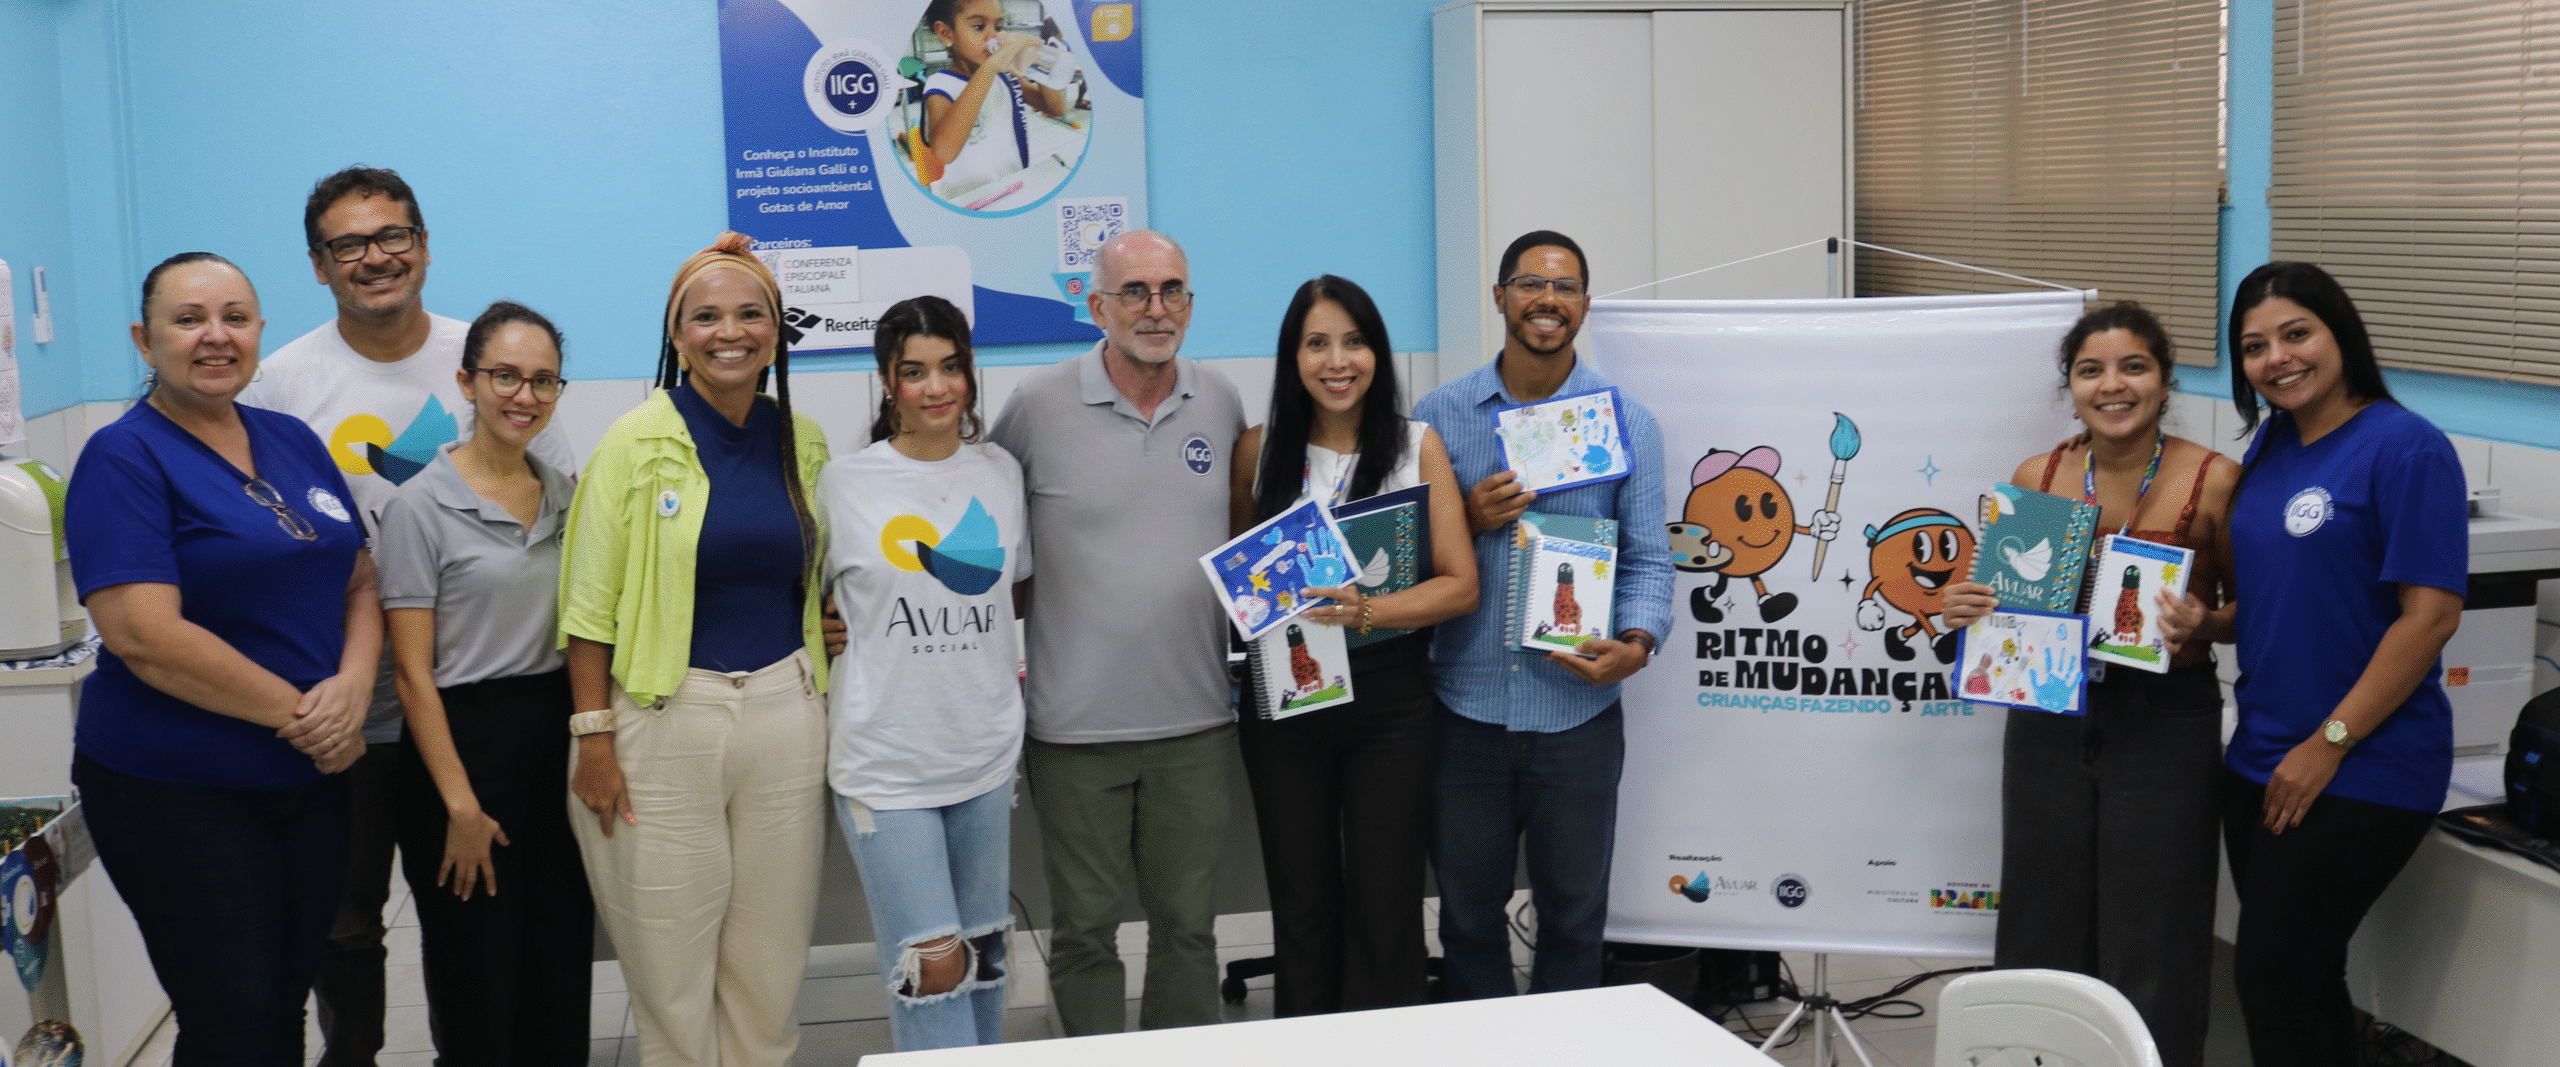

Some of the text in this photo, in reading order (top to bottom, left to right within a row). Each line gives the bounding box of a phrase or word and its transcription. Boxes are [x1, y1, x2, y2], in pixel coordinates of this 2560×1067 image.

[830, 73, 875, 95] IIGG
[743, 146, 859, 161] Conheça o Instituto
[736, 163, 869, 179] Irmã Giuliana Galli e o
[736, 180, 873, 199] projeto socioambiental
[758, 200, 850, 214] Gotas de Amor
[749, 237, 812, 250] Parceiros:
[784, 257, 853, 269] CONFERENZA
[785, 270, 847, 281] EPISCOPALE
[786, 284, 831, 294] ITALIANA
[825, 316, 878, 332] Receita
[886, 597, 996, 637] AVUAR
[912, 642, 978, 654] SOCIAL
[1696, 627, 1828, 664] RITMO
[1699, 670, 1730, 687] DE
[1697, 692, 1975, 717] CRIANÇAS FAZENDO ARTE
